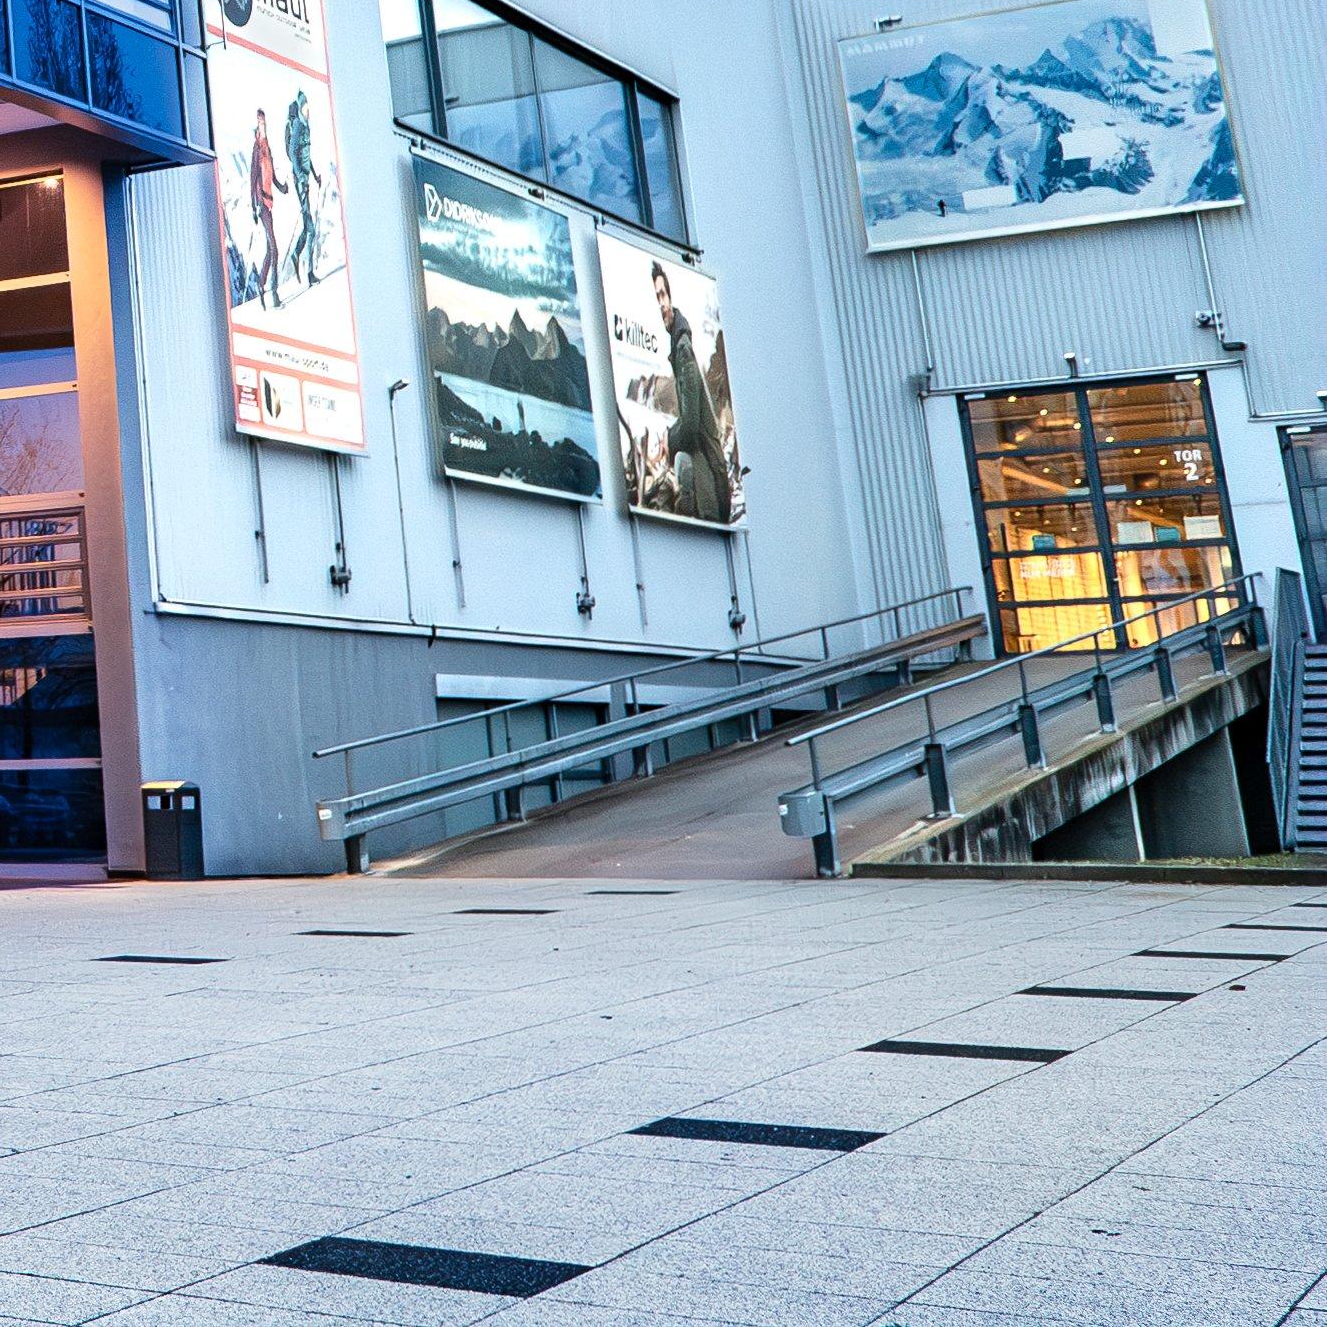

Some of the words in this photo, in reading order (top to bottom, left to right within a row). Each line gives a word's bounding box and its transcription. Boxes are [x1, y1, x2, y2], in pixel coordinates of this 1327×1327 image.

[624, 317, 659, 354] killtec
[1173, 449, 1203, 463] TOR
[1183, 462, 1200, 482] 2
